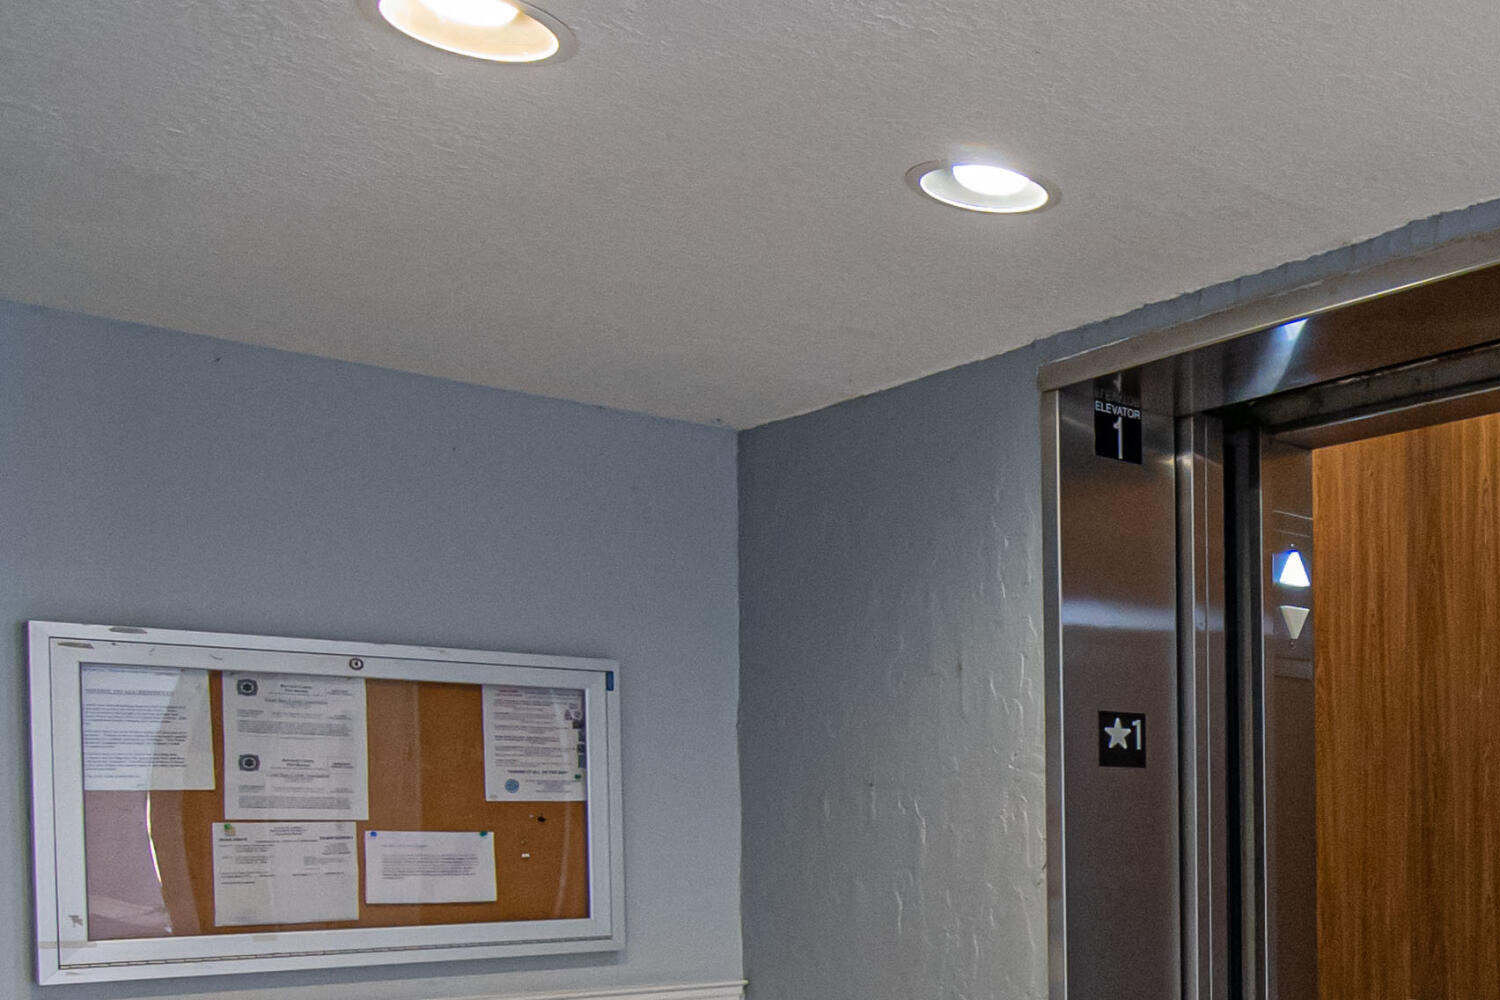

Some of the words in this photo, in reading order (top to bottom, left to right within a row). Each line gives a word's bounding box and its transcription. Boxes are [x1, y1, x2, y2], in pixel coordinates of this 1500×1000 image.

[1095, 399, 1141, 419] ELEVATOR
[1113, 416, 1123, 460] 1
[1132, 719, 1141, 750] 1
